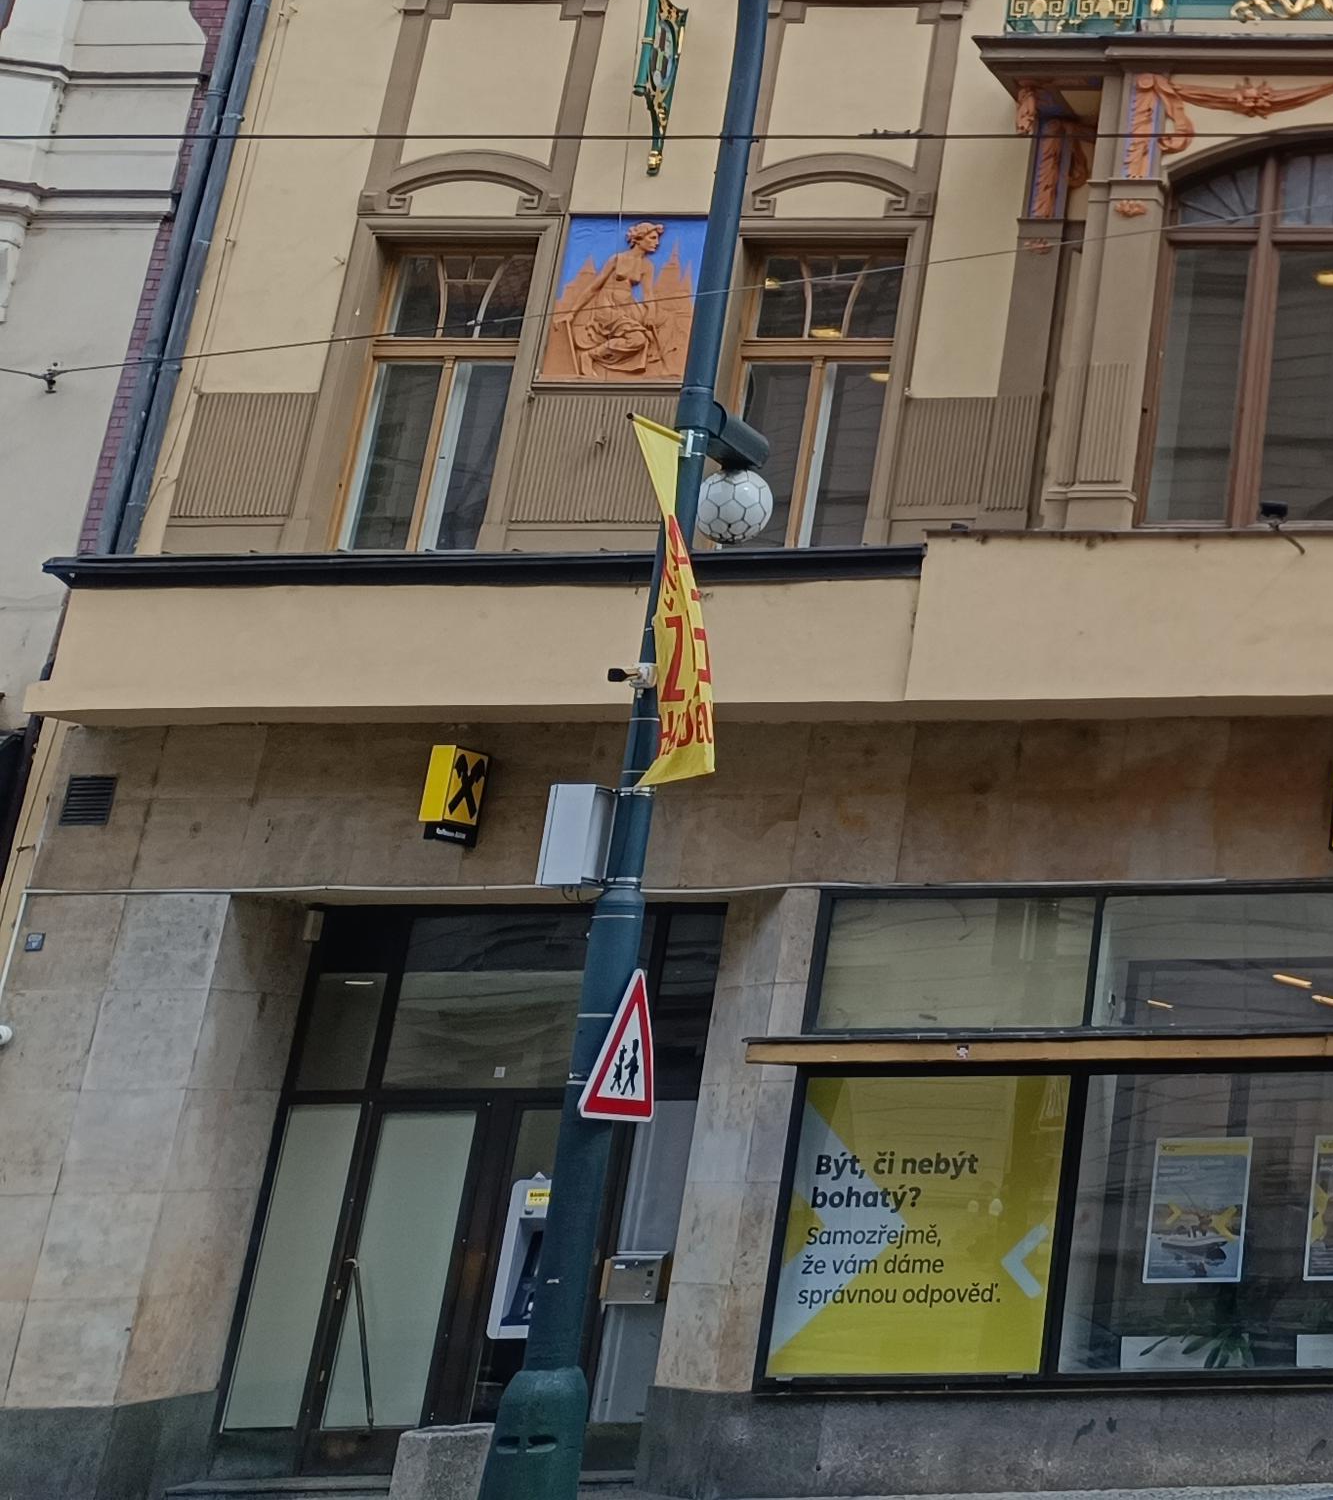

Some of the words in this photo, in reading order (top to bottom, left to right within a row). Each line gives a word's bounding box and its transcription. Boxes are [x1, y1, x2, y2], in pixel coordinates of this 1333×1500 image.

[815, 1153, 866, 1181] Být,
[873, 1151, 895, 1175] či
[901, 1151, 979, 1180] nebýt
[810, 1186, 921, 1213] bohatý?
[805, 1224, 942, 1249] Samozřejmě,
[801, 1254, 826, 1274] že
[832, 1254, 878, 1274] vám
[884, 1254, 944, 1274] dáme
[797, 1284, 897, 1308] správnou
[902, 1283, 1001, 1308] odpověď.
